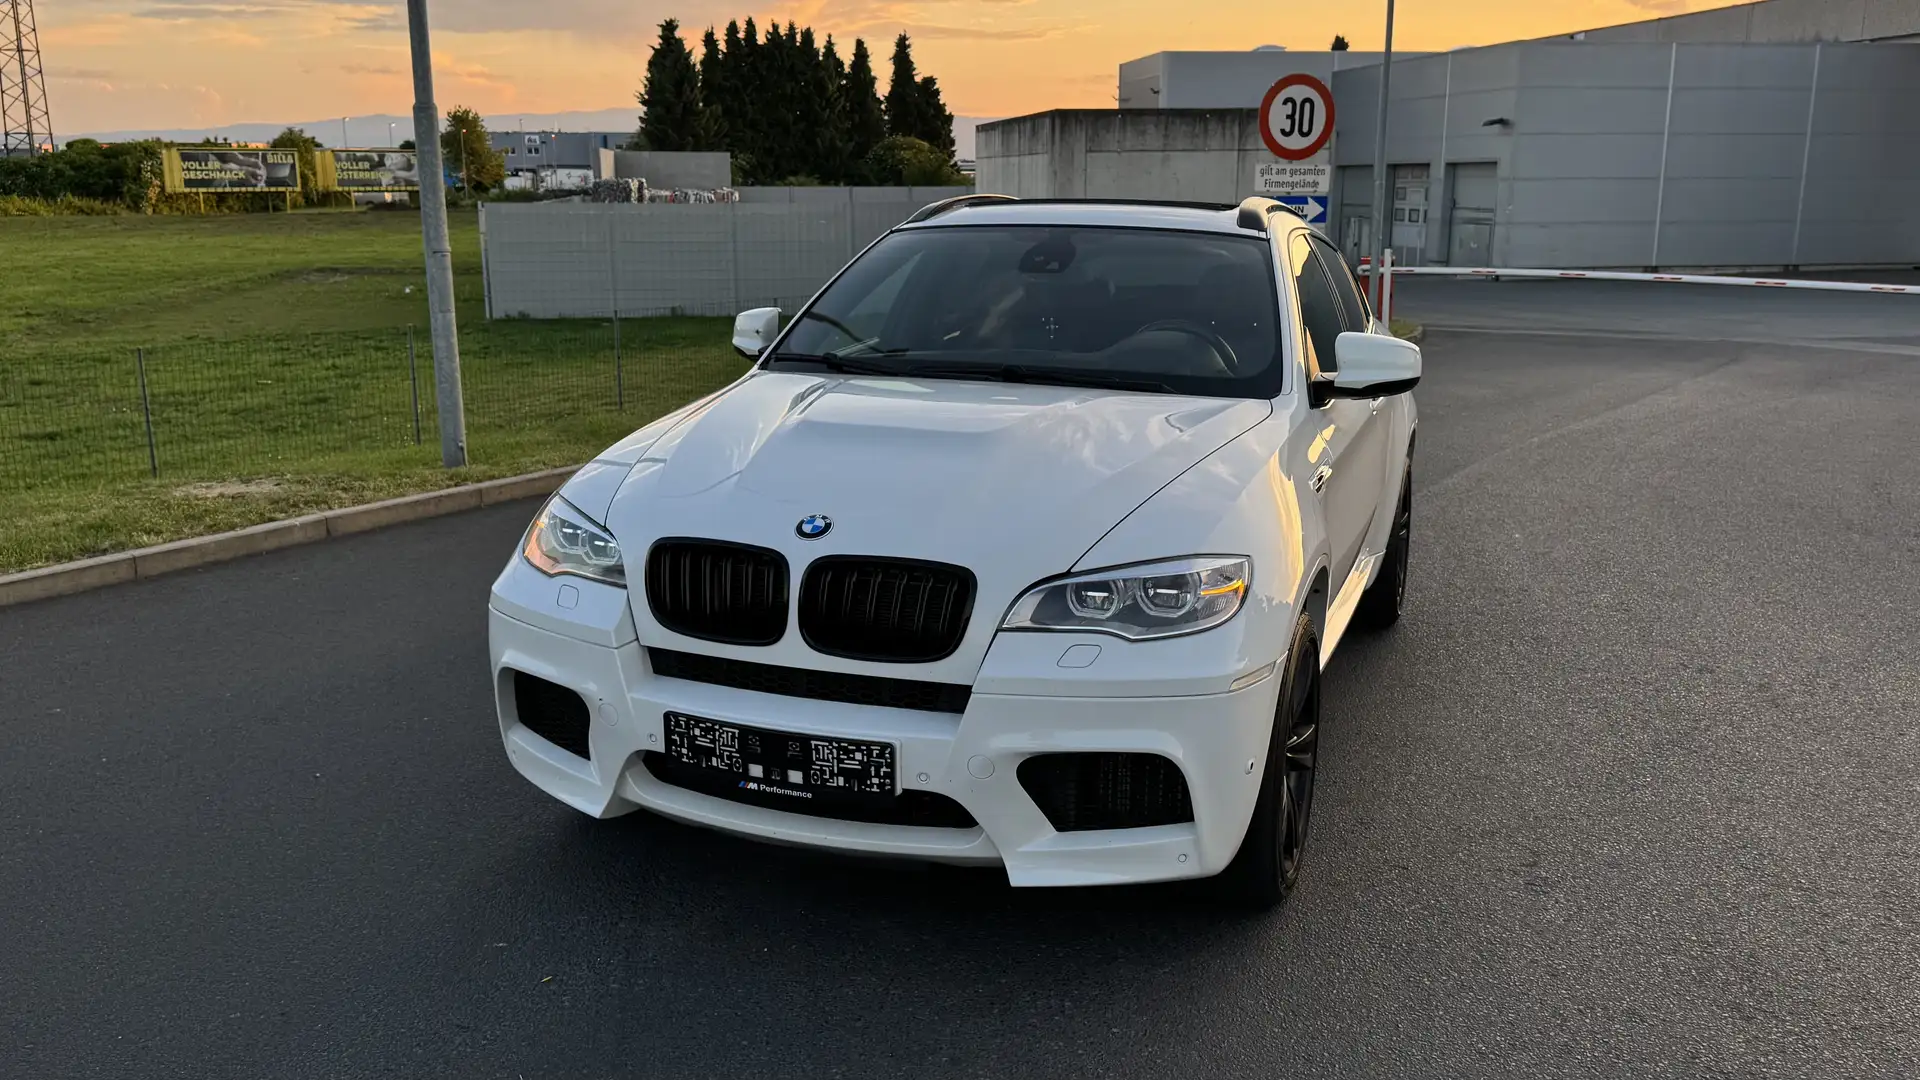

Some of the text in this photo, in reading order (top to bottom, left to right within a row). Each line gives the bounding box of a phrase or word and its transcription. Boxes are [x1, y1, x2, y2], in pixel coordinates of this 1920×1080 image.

[1280, 97, 1315, 137] 30
[267, 154, 294, 164] BILLA
[182, 162, 221, 170] VOLLER
[335, 161, 370, 169] VOLLER
[183, 171, 246, 179] GESCHMACK
[336, 169, 392, 179] ÖSTERREIC
[1260, 165, 1326, 177] gilt am gesamten
[1264, 179, 1319, 190] Firmengelände
[760, 784, 812, 798] Performance
